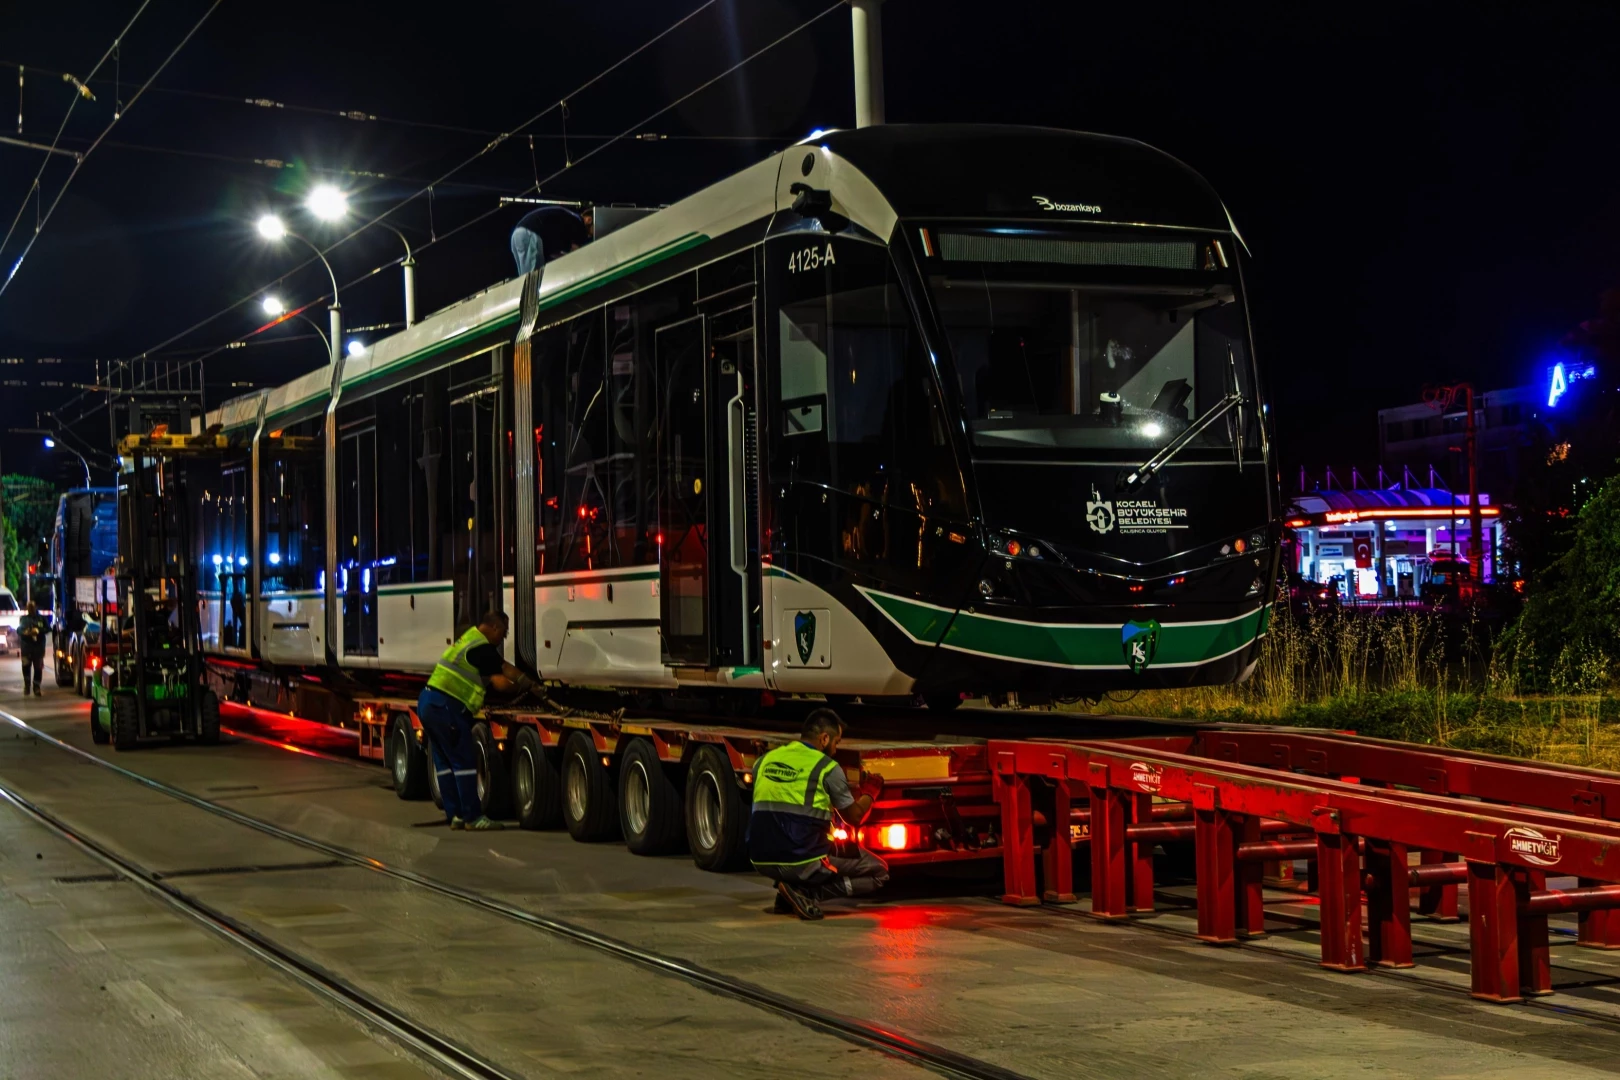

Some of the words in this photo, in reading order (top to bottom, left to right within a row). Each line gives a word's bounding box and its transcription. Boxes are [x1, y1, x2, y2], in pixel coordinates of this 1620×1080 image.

[1054, 202, 1102, 214] bozankaya
[788, 243, 836, 274] 4125-A
[1117, 508, 1188, 518] BÜYÜKŞEHİR
[1118, 517, 1172, 525] BELEDİYESİ
